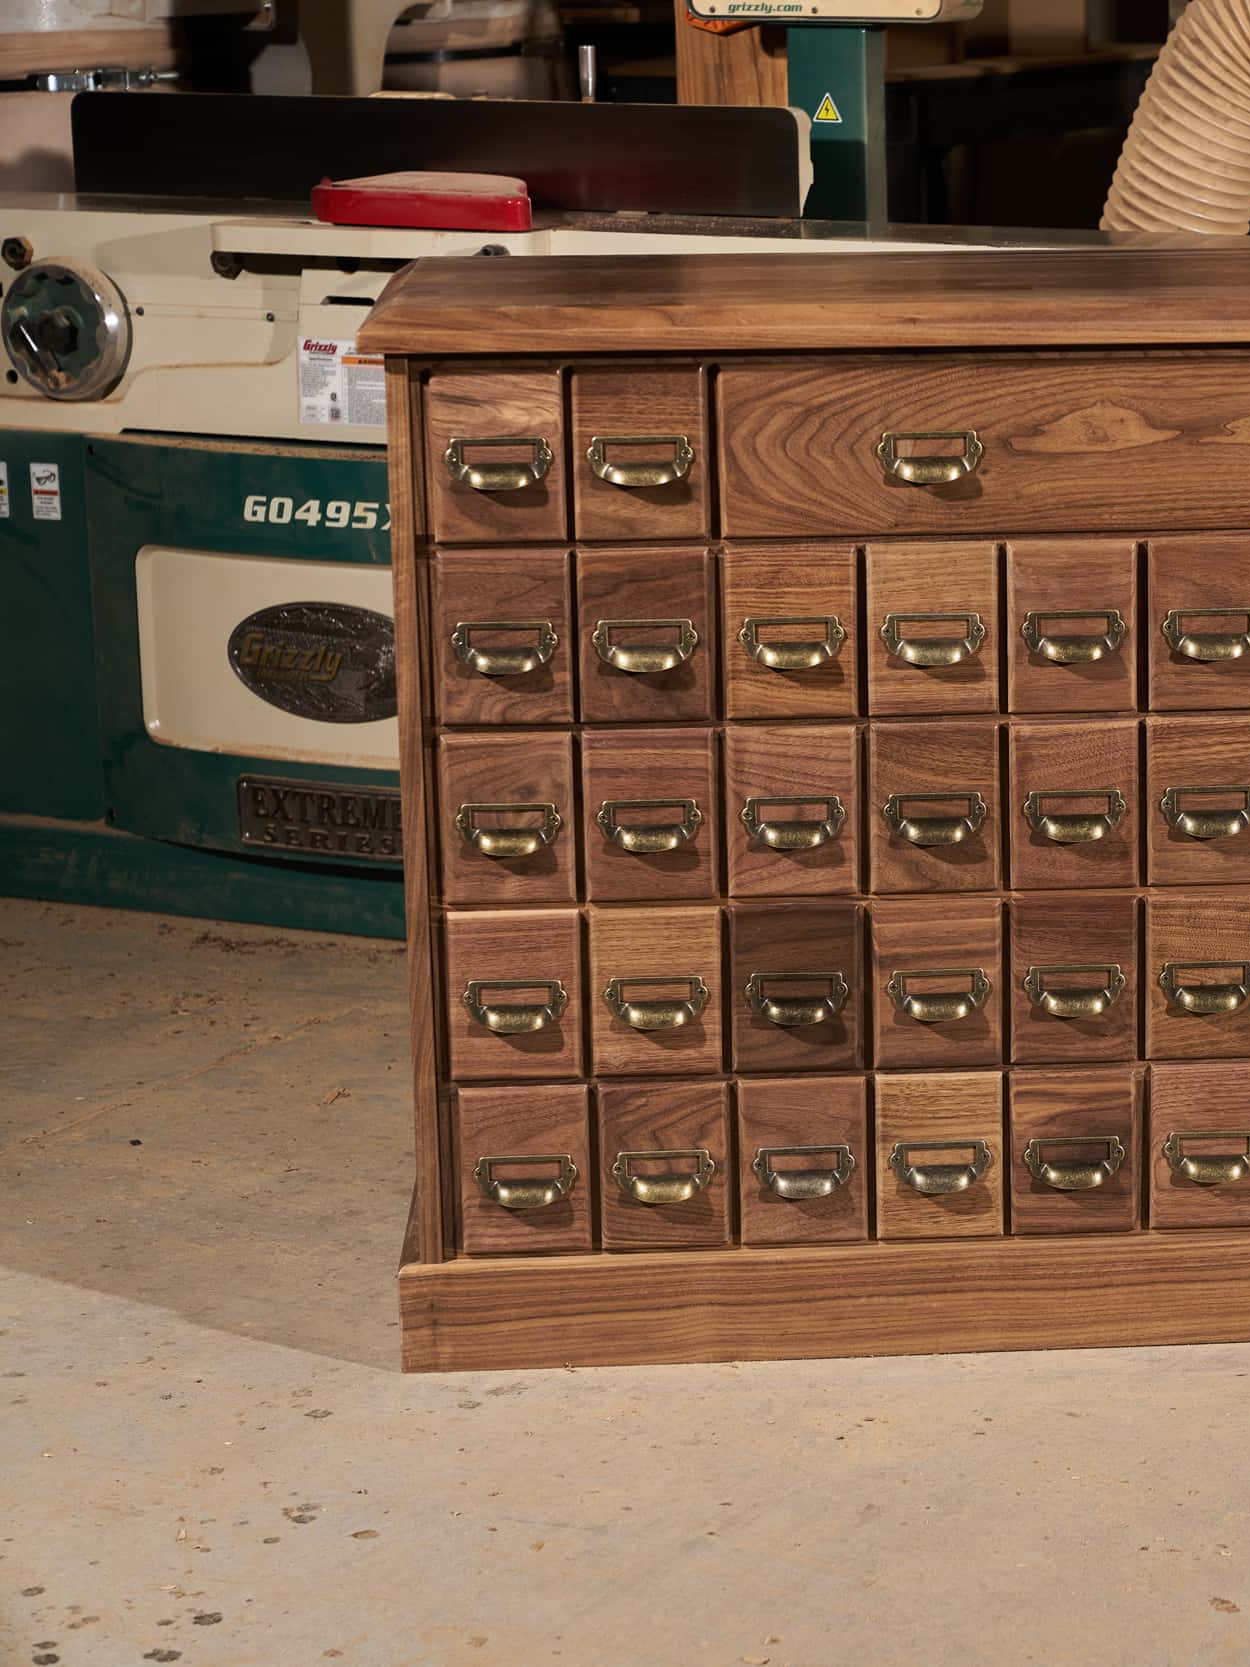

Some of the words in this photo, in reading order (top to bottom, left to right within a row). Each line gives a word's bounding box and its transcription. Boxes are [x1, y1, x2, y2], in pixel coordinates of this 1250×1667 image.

[728, 2, 803, 14] grizzly.com
[303, 339, 338, 355] Grizzly
[239, 631, 342, 682] Grizzly
[263, 823, 394, 855] SERIES
